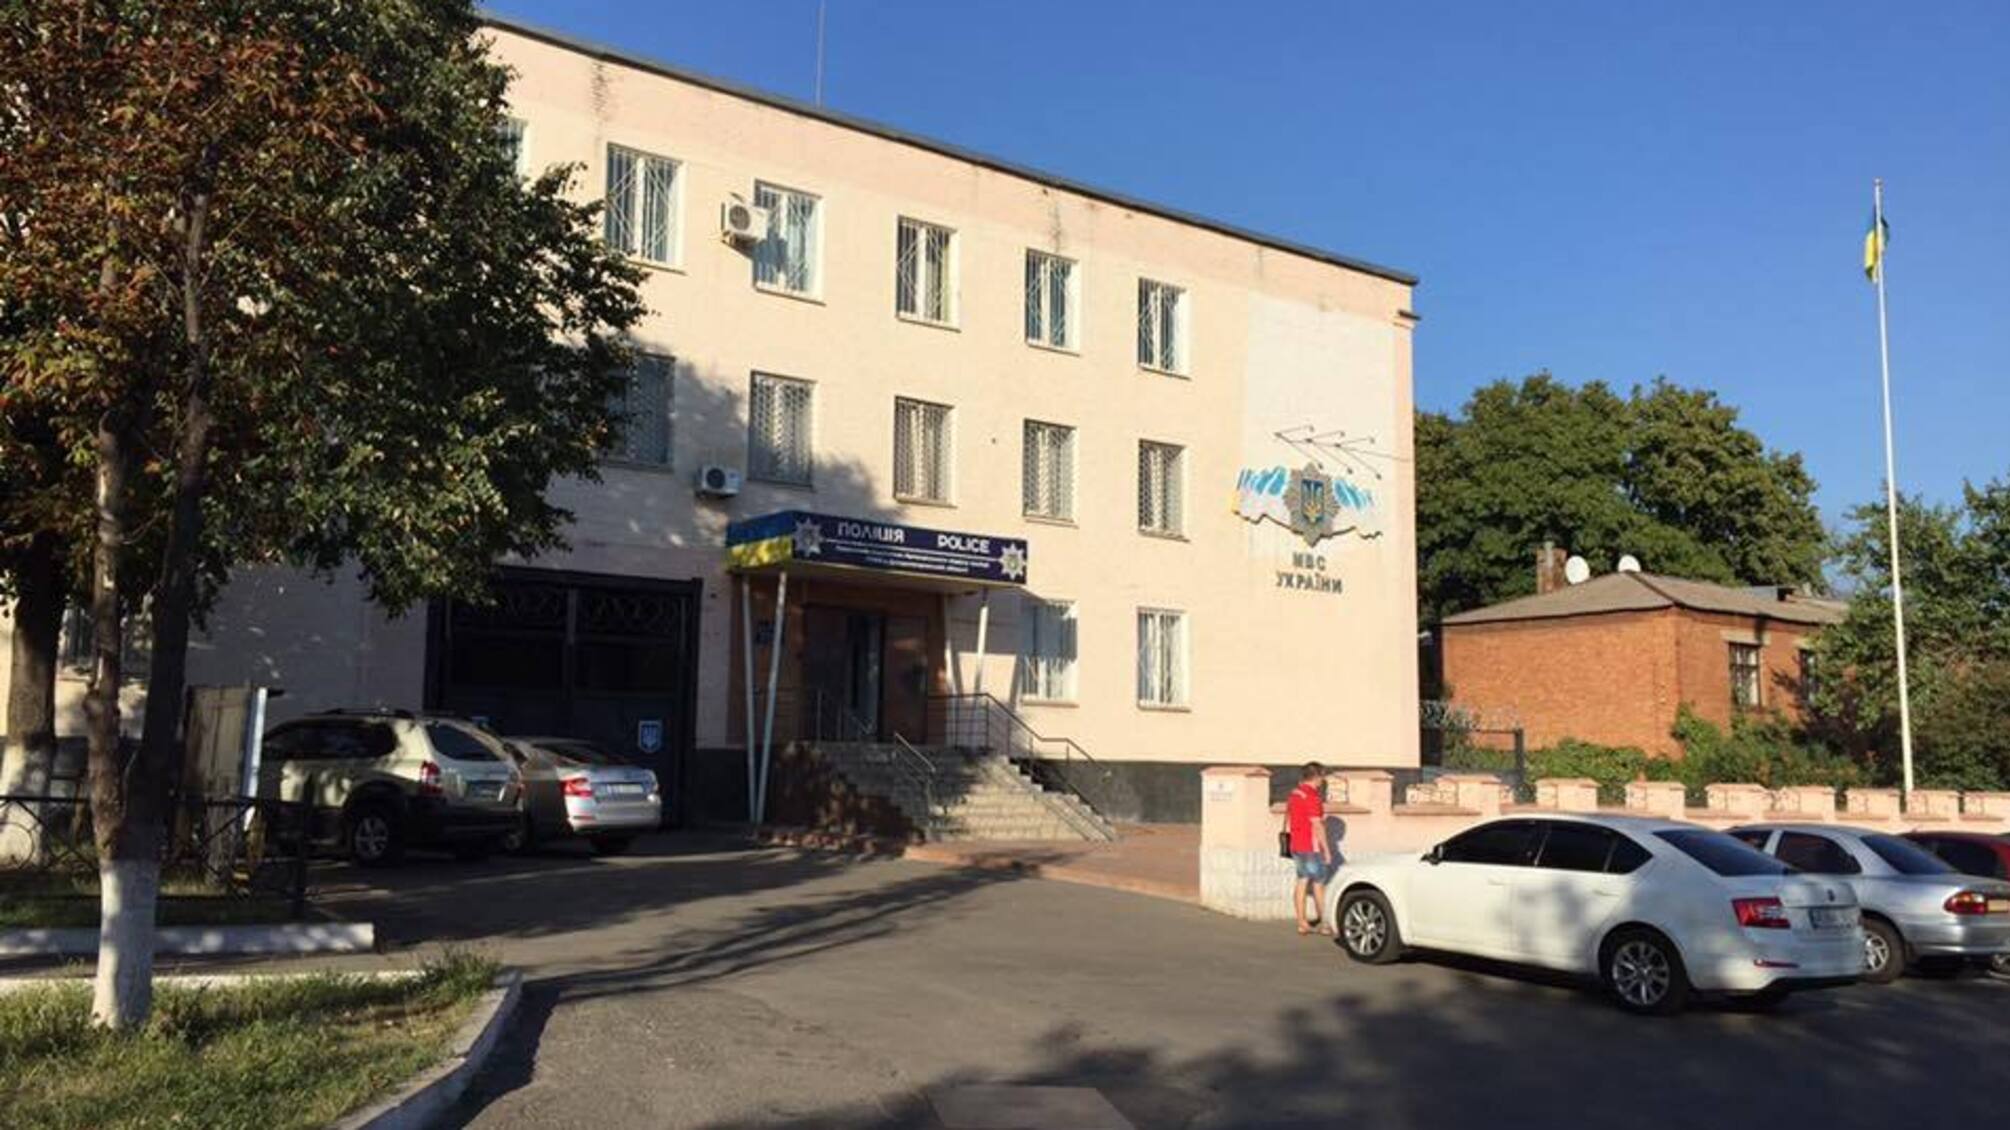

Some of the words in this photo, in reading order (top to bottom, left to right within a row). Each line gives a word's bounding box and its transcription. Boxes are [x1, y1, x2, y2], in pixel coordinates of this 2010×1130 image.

[838, 522, 905, 543] ПОЛІЦІЯ
[937, 534, 990, 553] POLICE
[1293, 552, 1326, 571] МВС
[1275, 572, 1342, 593] УКРАЇНИ
